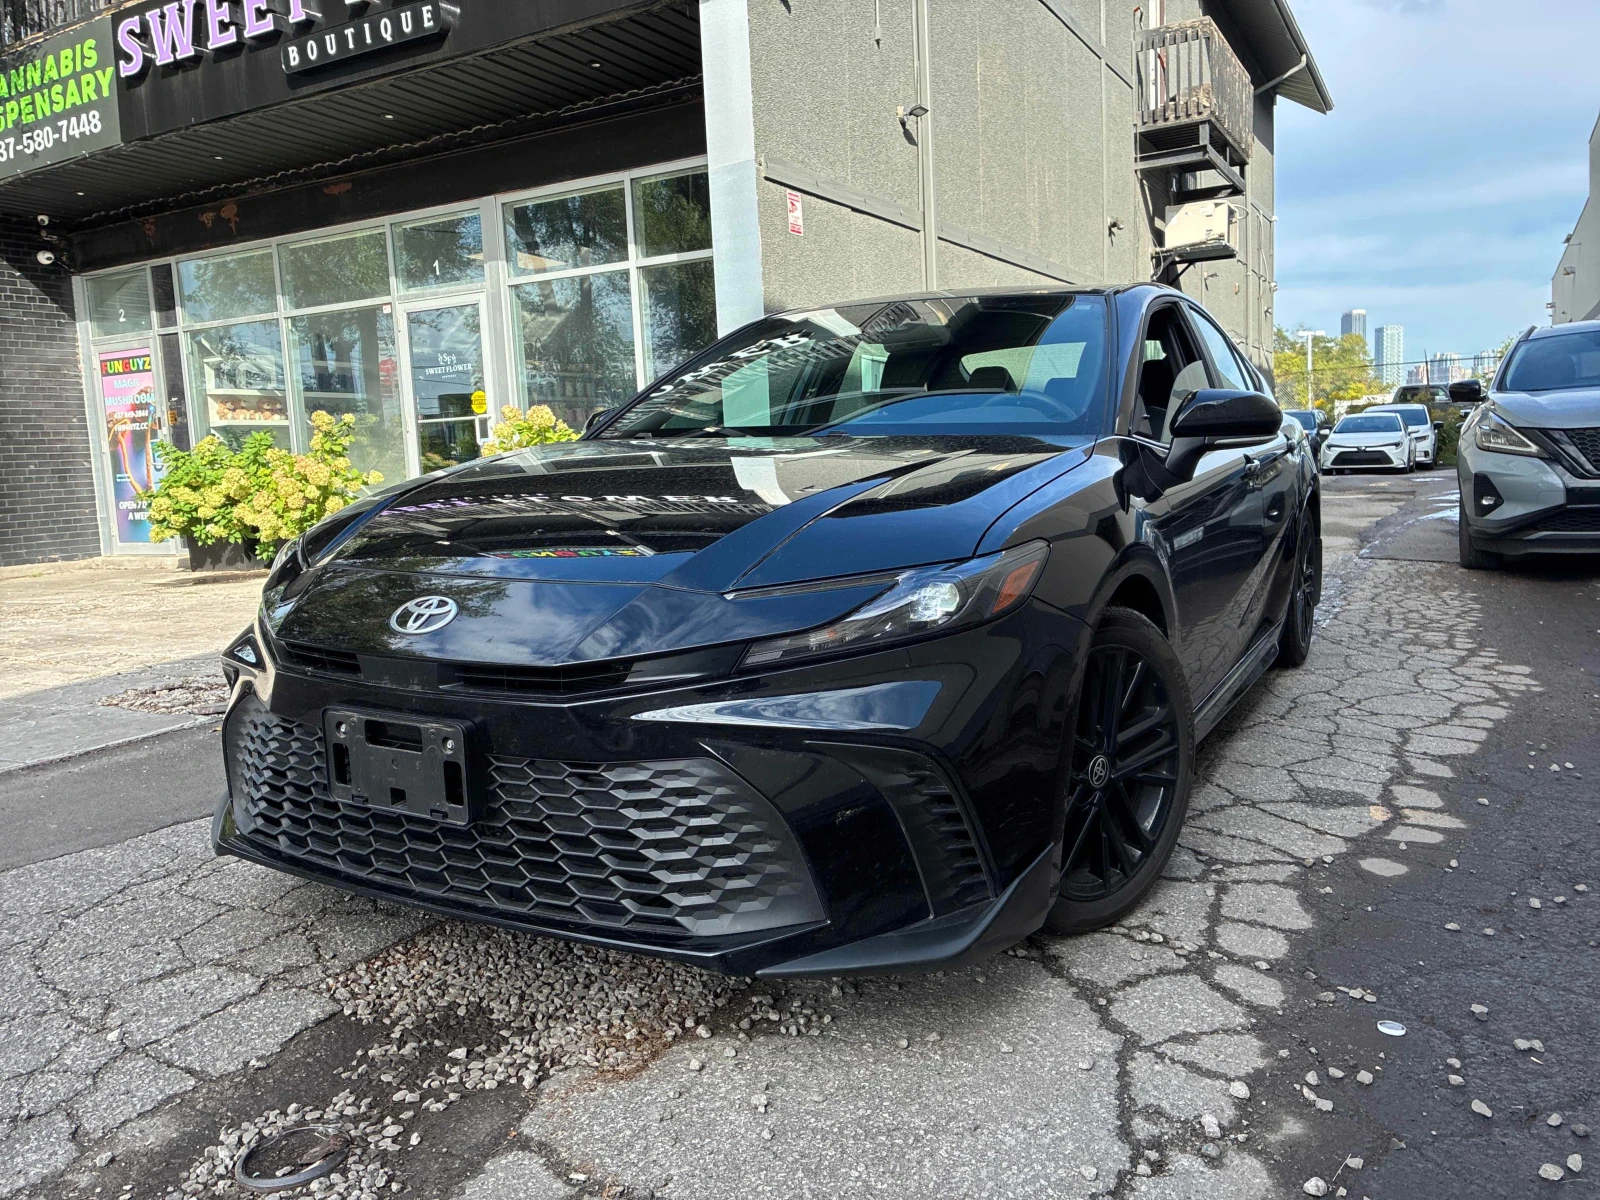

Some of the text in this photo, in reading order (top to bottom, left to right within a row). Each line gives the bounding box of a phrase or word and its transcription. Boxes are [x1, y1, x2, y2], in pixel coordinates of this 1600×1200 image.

[287, 5, 434, 67] BOUTIQUE
[432, 259, 440, 276] 1
[118, 308, 126, 322] 2
[101, 356, 152, 374] FUNGUYZ
[425, 363, 472, 375] SWEET FLOWER
[113, 378, 140, 389] MAGIC
[105, 393, 155, 406] MUSHROOM
